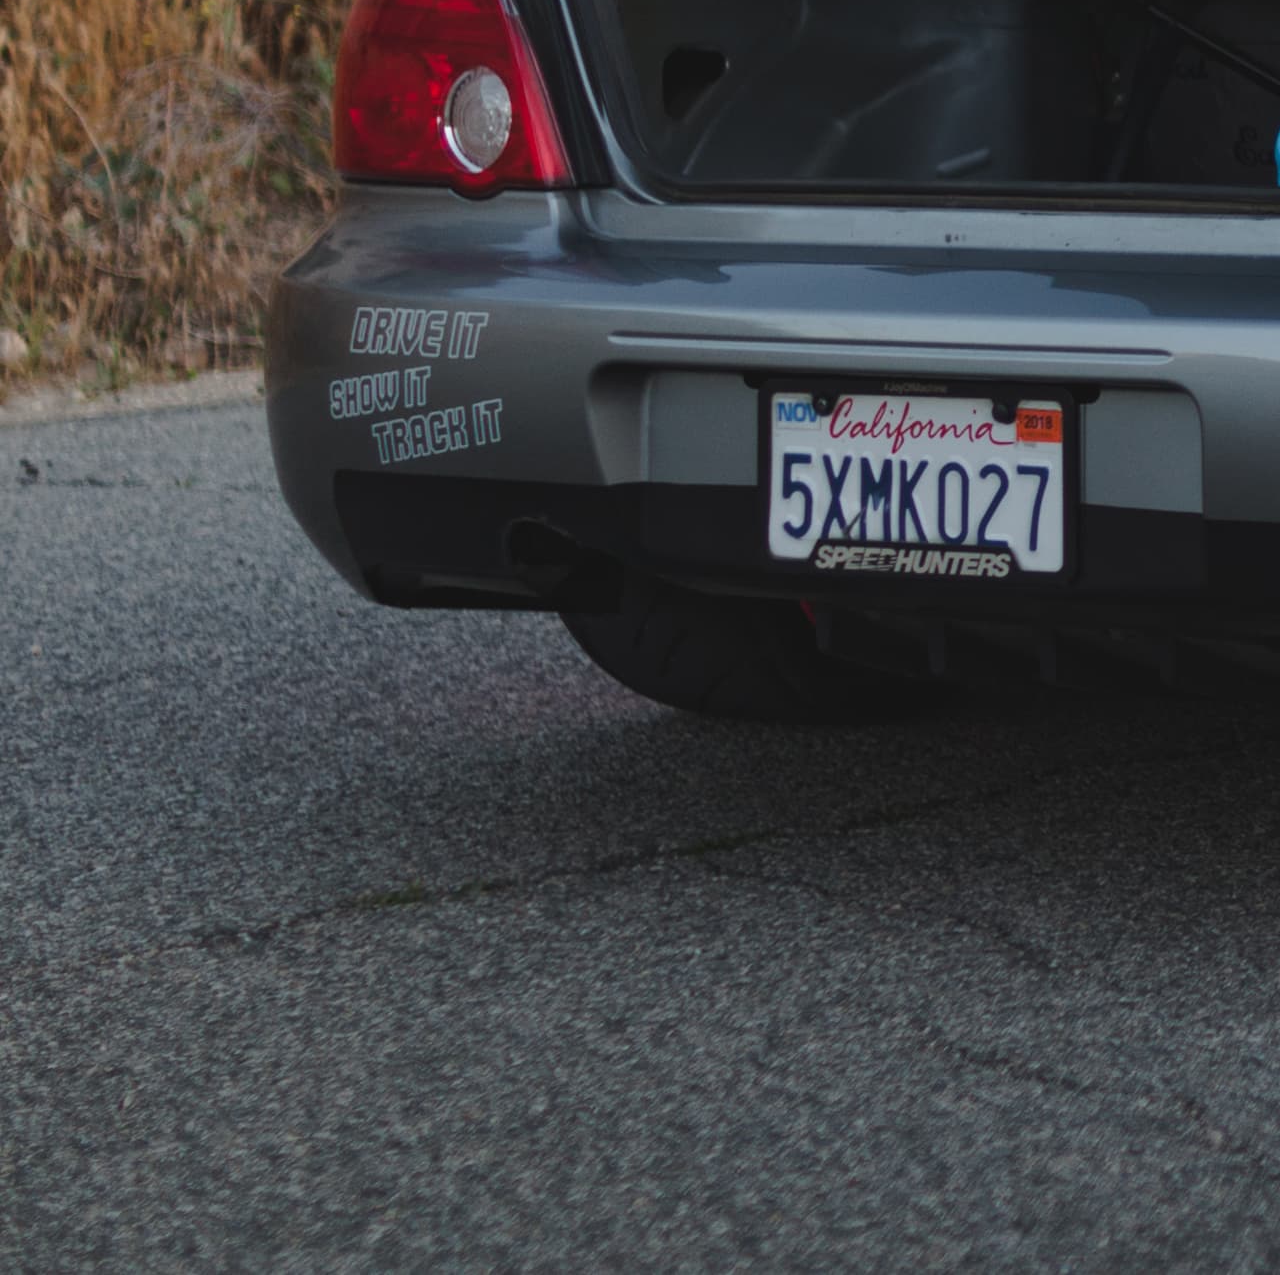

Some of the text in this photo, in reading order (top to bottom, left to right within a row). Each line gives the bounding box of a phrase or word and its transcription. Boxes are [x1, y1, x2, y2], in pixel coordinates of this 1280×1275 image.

[350, 306, 489, 359] DRIVE IT
[329, 365, 432, 419] SHOW IT
[371, 398, 503, 464] TRACK IT
[777, 401, 818, 423] NOV
[829, 398, 1015, 454] California
[782, 453, 1050, 552] 5XMK027
[814, 544, 1011, 577] SPEEDHUNTERS
